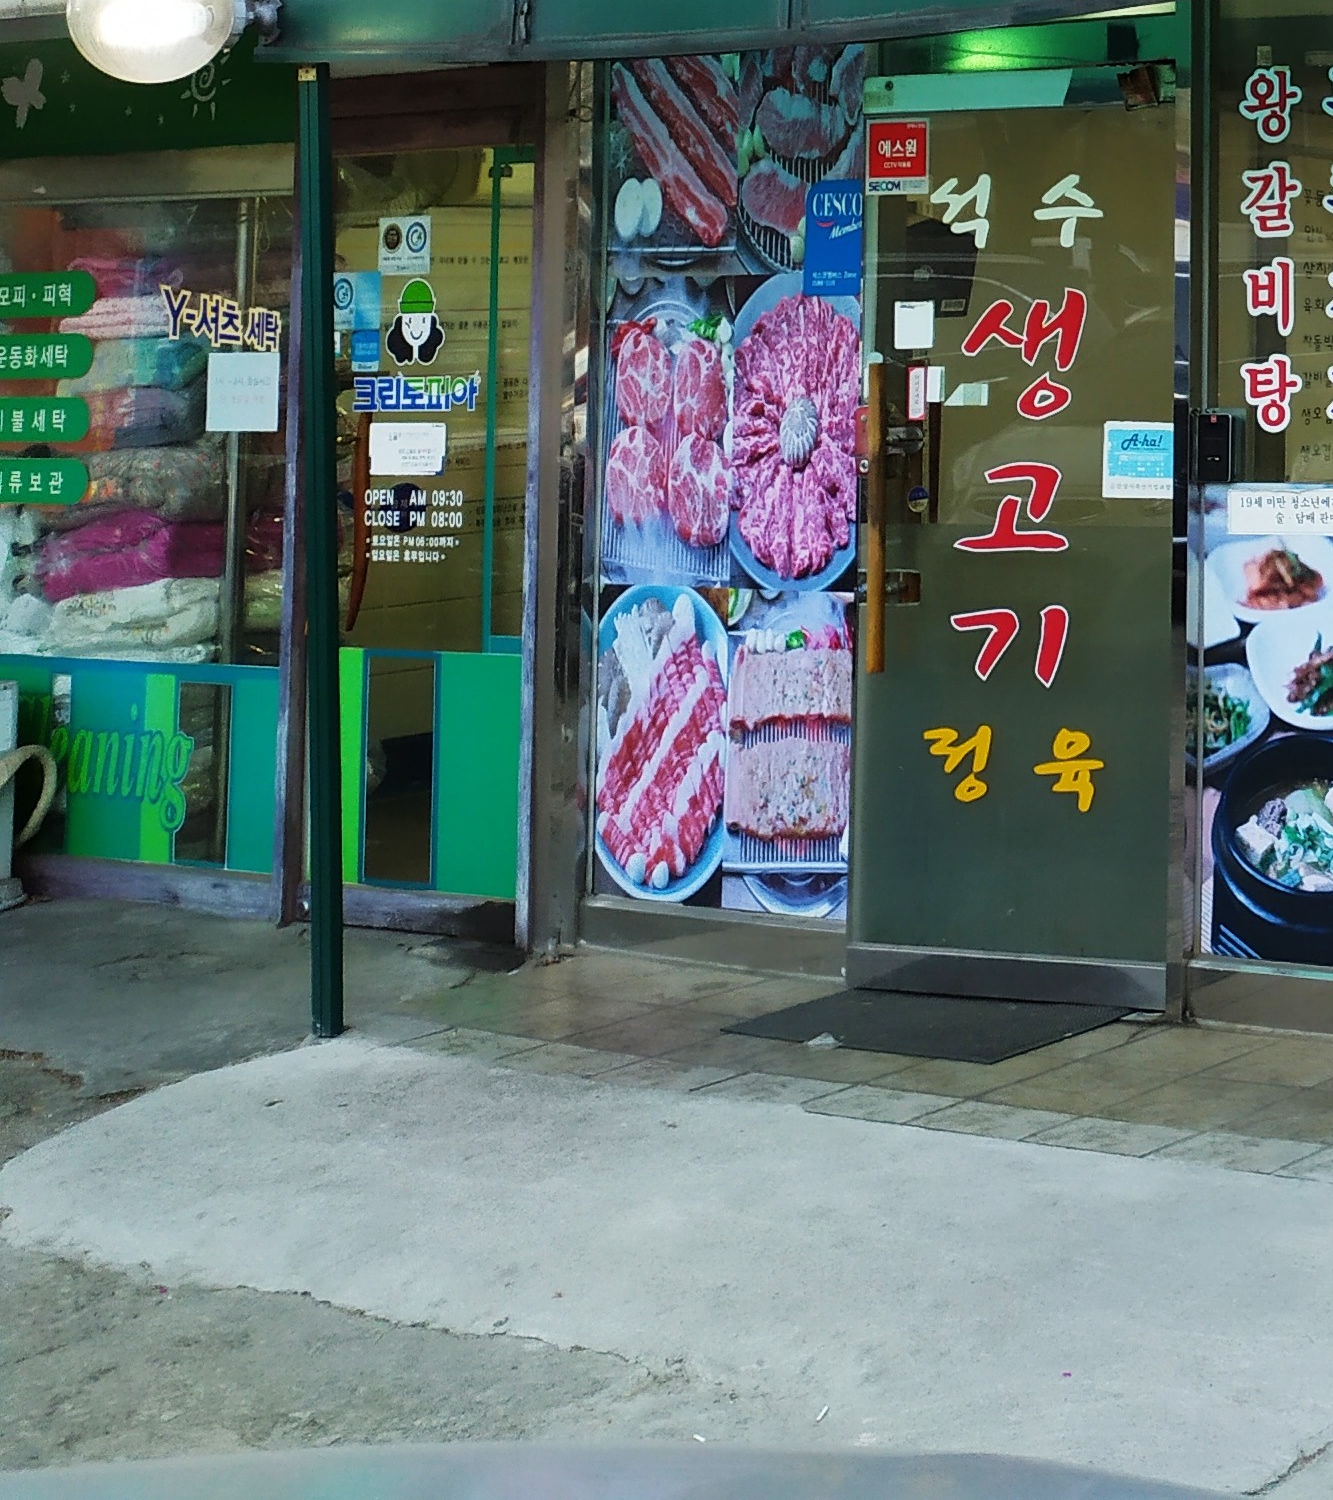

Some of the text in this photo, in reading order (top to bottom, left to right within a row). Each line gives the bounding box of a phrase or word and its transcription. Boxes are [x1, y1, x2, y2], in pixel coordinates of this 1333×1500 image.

[878, 139, 917, 158] 에스원
[869, 181, 901, 192] SECOM
[812, 192, 863, 217] CESCO
[929, 173, 1104, 249] 석수
[1240, 66, 1301, 434] 왕갈비탕
[160, 284, 281, 352] Y-셔츠 세탁
[353, 370, 482, 412] 크린토피아
[364, 489, 463, 507] OPEN AM 09:30
[951, 287, 1089, 688] 생고기
[1240, 497, 1263, 508] 19세
[1266, 496, 1286, 508] 미만
[364, 510, 463, 528] CLOSE PM 08:00
[1296, 512, 1315, 524] 담배
